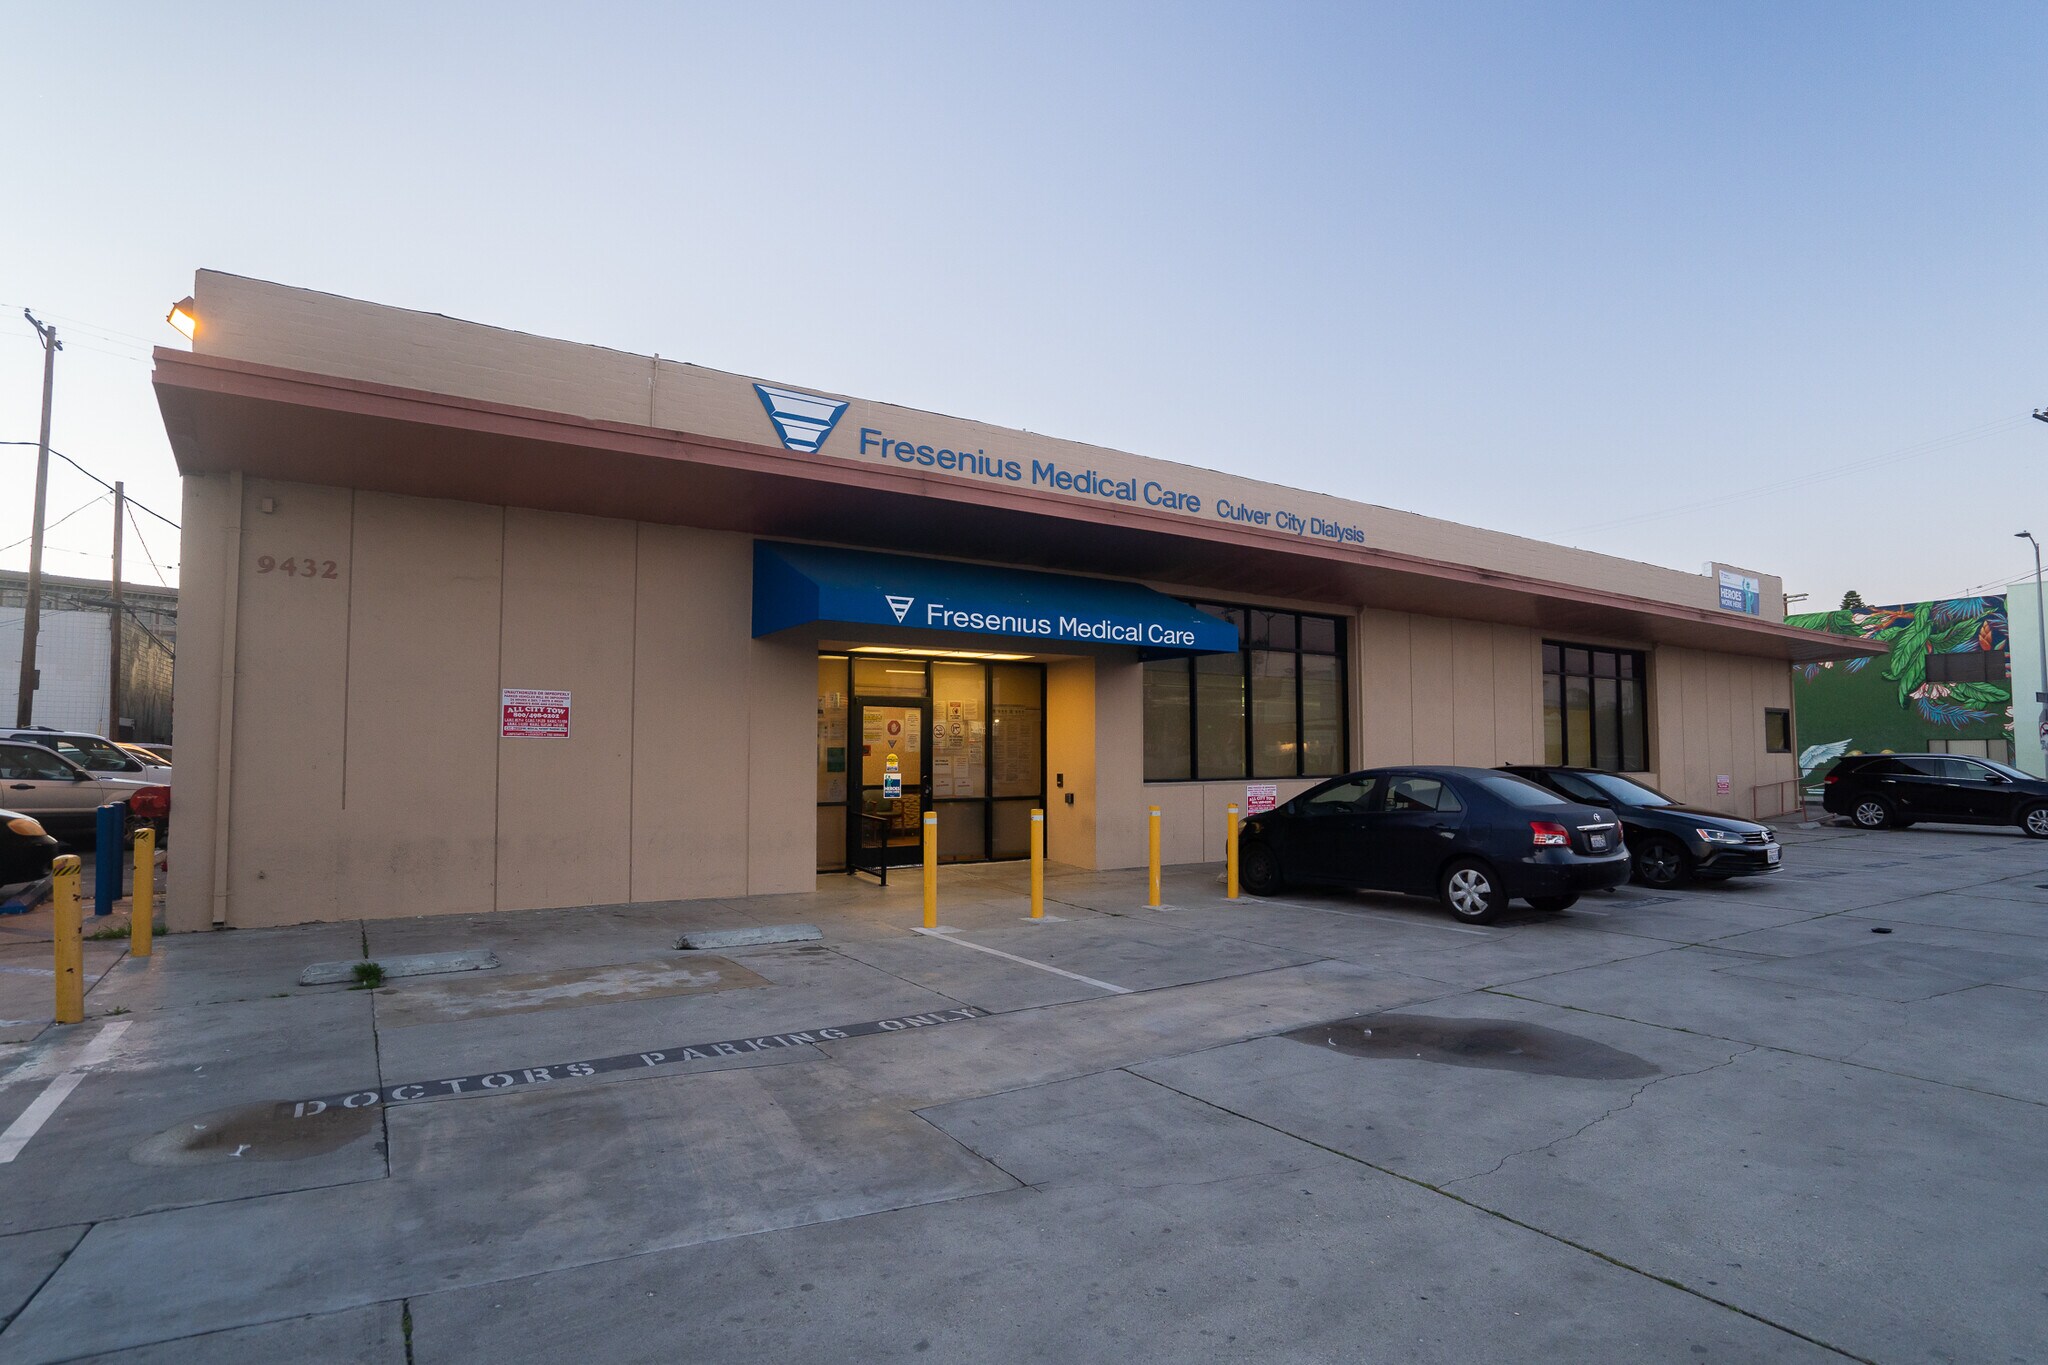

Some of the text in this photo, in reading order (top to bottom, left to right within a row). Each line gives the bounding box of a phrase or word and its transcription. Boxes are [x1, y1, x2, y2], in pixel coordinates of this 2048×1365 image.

[860, 427, 1201, 513] Fresenius Medical Care
[1216, 498, 1365, 544] Culver City Dialysis
[256, 555, 338, 580] 9432
[1720, 588, 1742, 601] HEROES
[1721, 598, 1733, 606] WORK
[927, 602, 1195, 645] Fresenius Medical Care
[293, 1008, 977, 1118] DOCTOR'S PARKING ONLY
